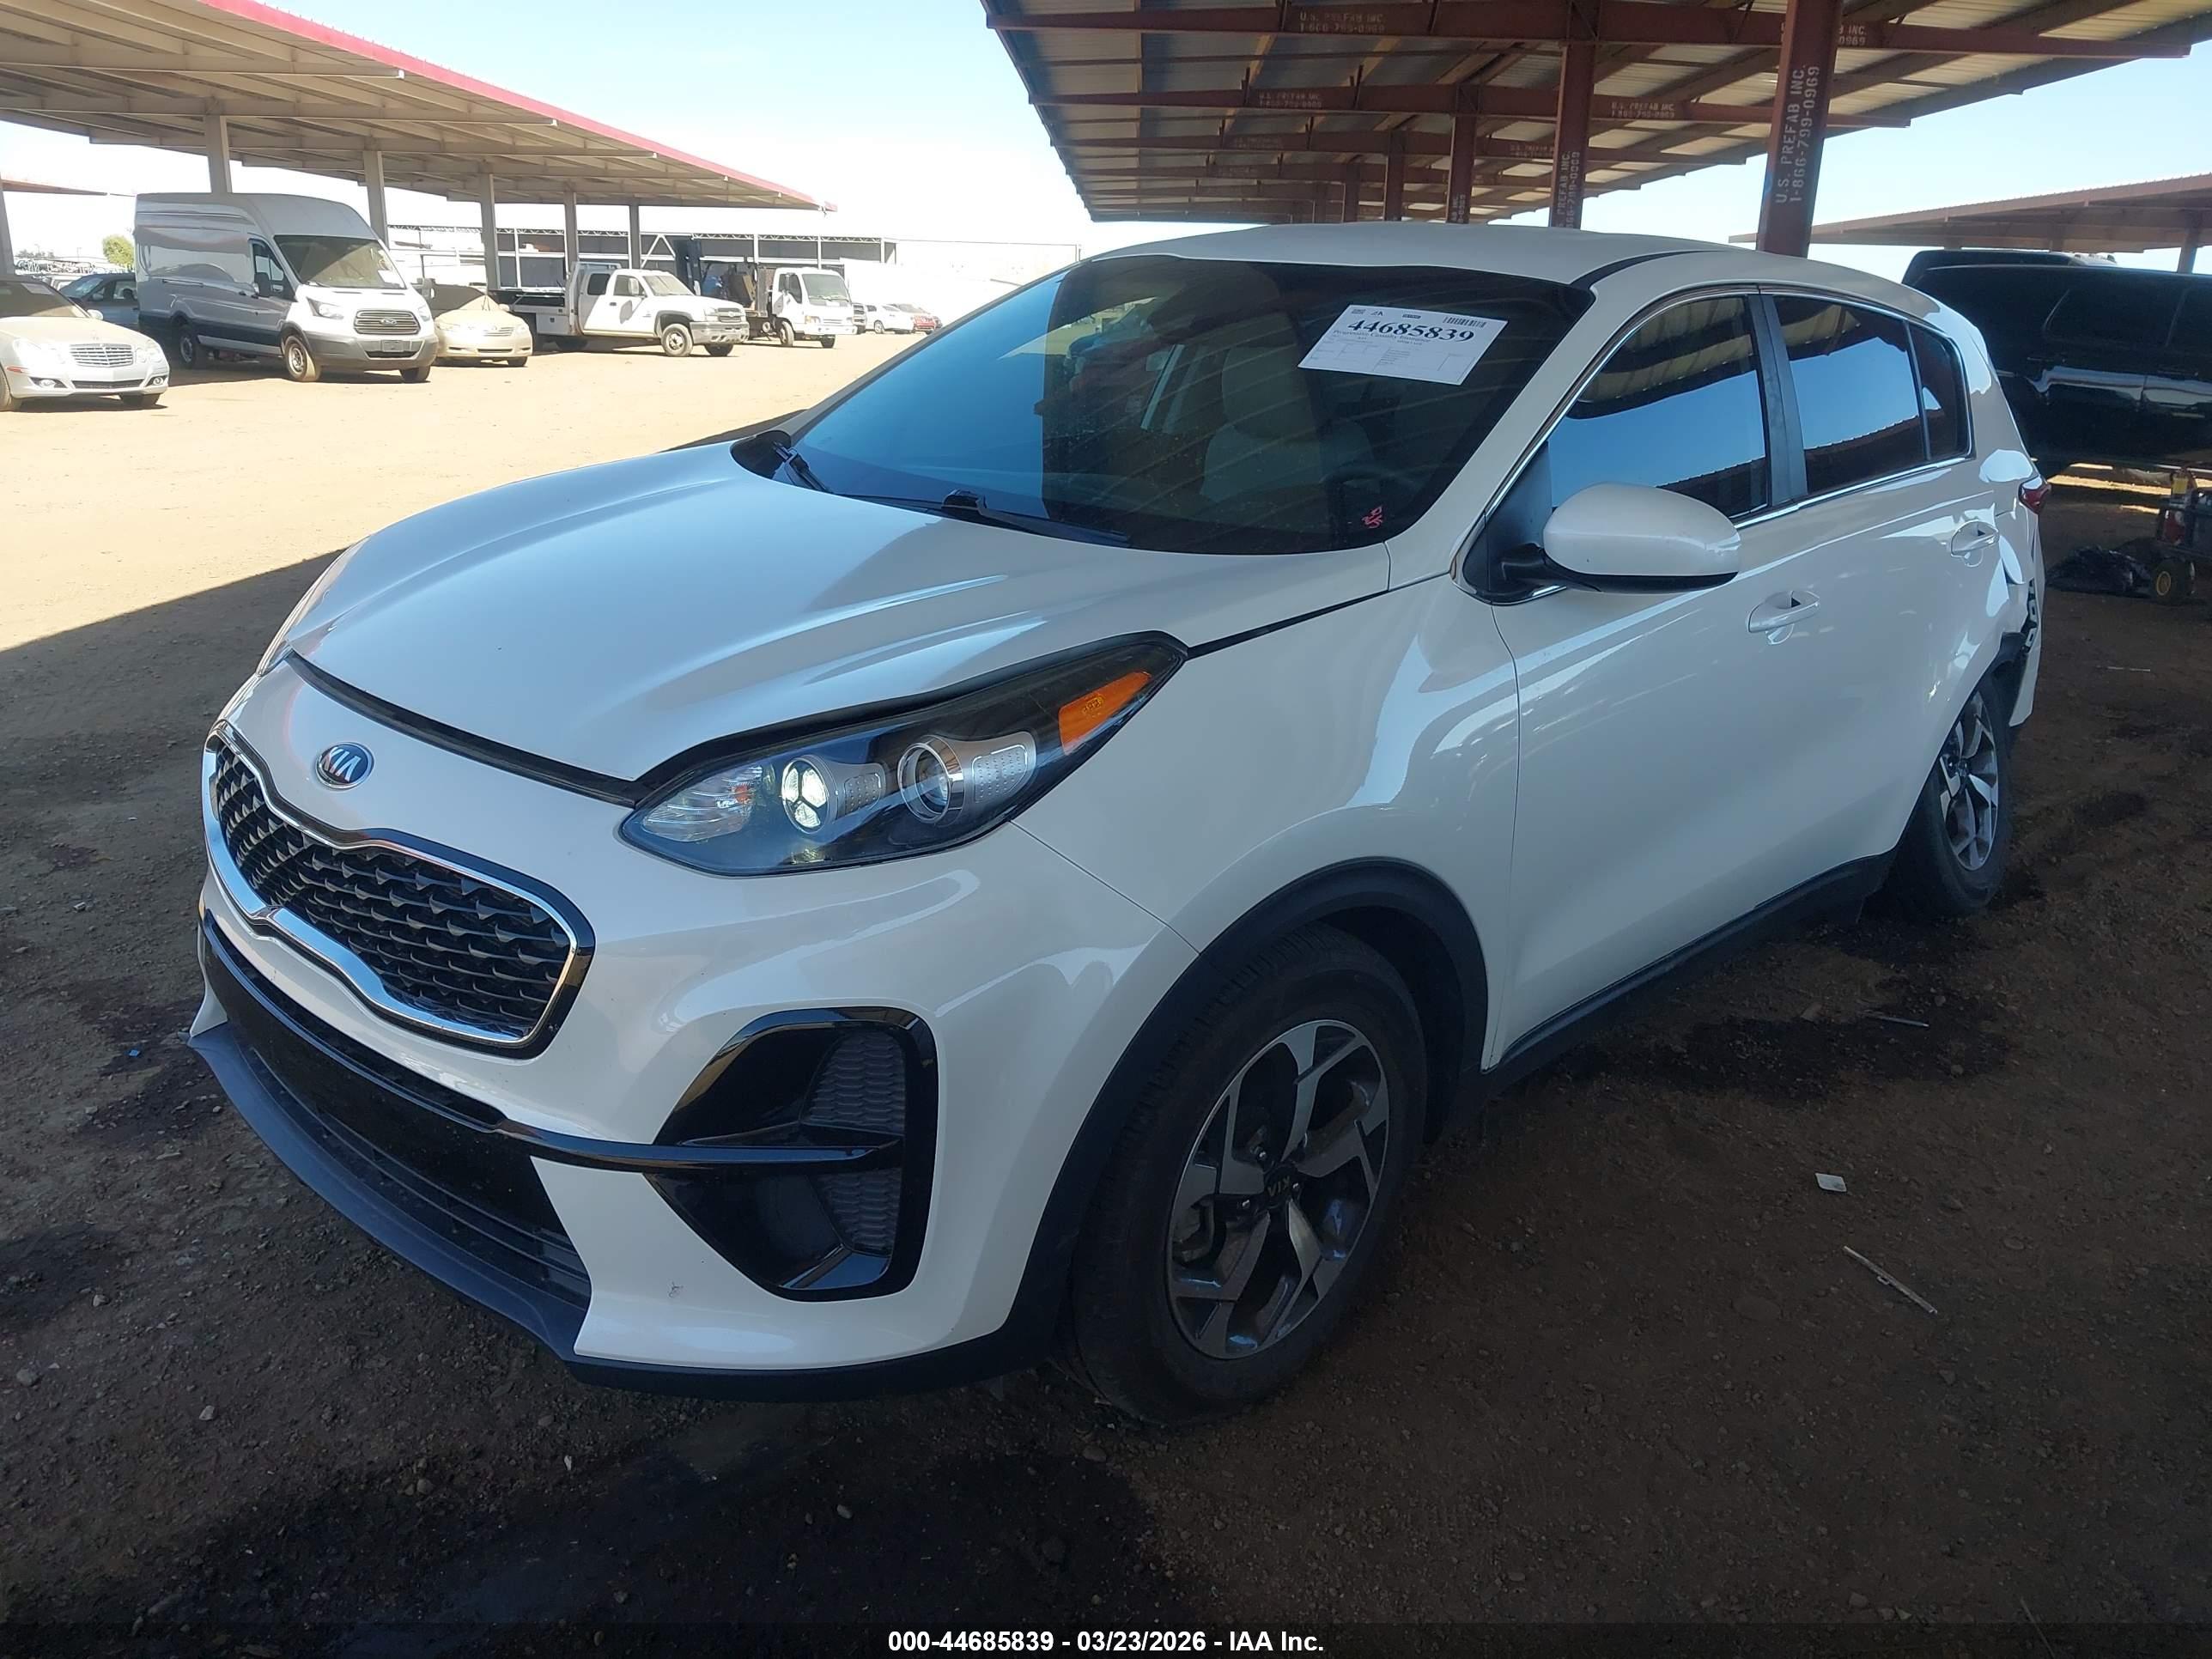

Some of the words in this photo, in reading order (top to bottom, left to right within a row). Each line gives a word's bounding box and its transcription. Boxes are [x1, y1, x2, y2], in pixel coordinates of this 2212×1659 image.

[1790, 64, 1806, 96] INC.
[1780, 102, 1802, 165] PREFAB
[1790, 65, 1820, 203] 1-866-799-0969
[1775, 173, 1791, 204] U.S.
[1347, 319, 1474, 343] 44685839
